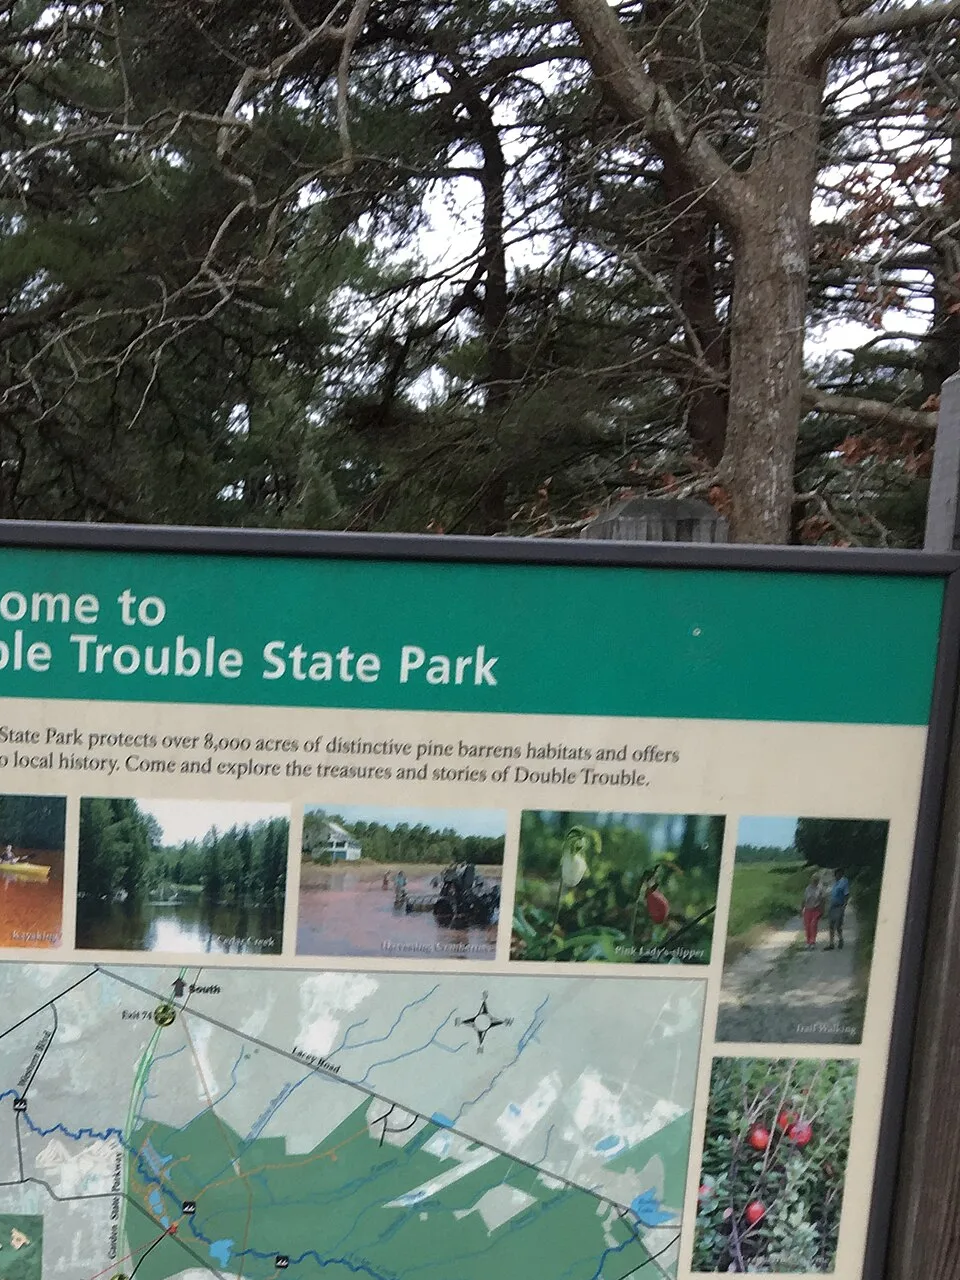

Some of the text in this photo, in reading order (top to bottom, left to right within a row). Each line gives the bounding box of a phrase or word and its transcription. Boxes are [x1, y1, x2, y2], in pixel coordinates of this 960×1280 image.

[118, 589, 165, 626] to
[70, 634, 243, 677] Trouble
[263, 641, 380, 683] State
[400, 645, 499, 686] Park
[44, 728, 84, 745] Park
[88, 733, 158, 750] protects
[161, 736, 200, 748] over
[203, 733, 252, 752] 8,000
[254, 739, 300, 752] acres
[303, 736, 324, 752] of
[325, 736, 413, 755] distinctive
[416, 740, 454, 760] pine
[457, 740, 522, 758] barrens
[525, 742, 593, 760] habitats
[595, 744, 628, 761] and
[631, 745, 680, 763] offers
[13, 751, 54, 769] local
[57, 752, 120, 775] history.
[124, 755, 177, 773] Come
[180, 757, 213, 774] and
[216, 758, 281, 779] explore
[285, 760, 313, 777] the
[316, 763, 393, 779] treasures
[395, 763, 429, 780] and
[432, 766, 488, 782] stories
[490, 766, 512, 782] of
[513, 767, 577, 784] Double
[579, 768, 650, 786] Trouble.
[188, 984, 221, 994] South
[121, 1010, 140, 1020] Exit
[291, 1046, 341, 1074] Lacey Road
